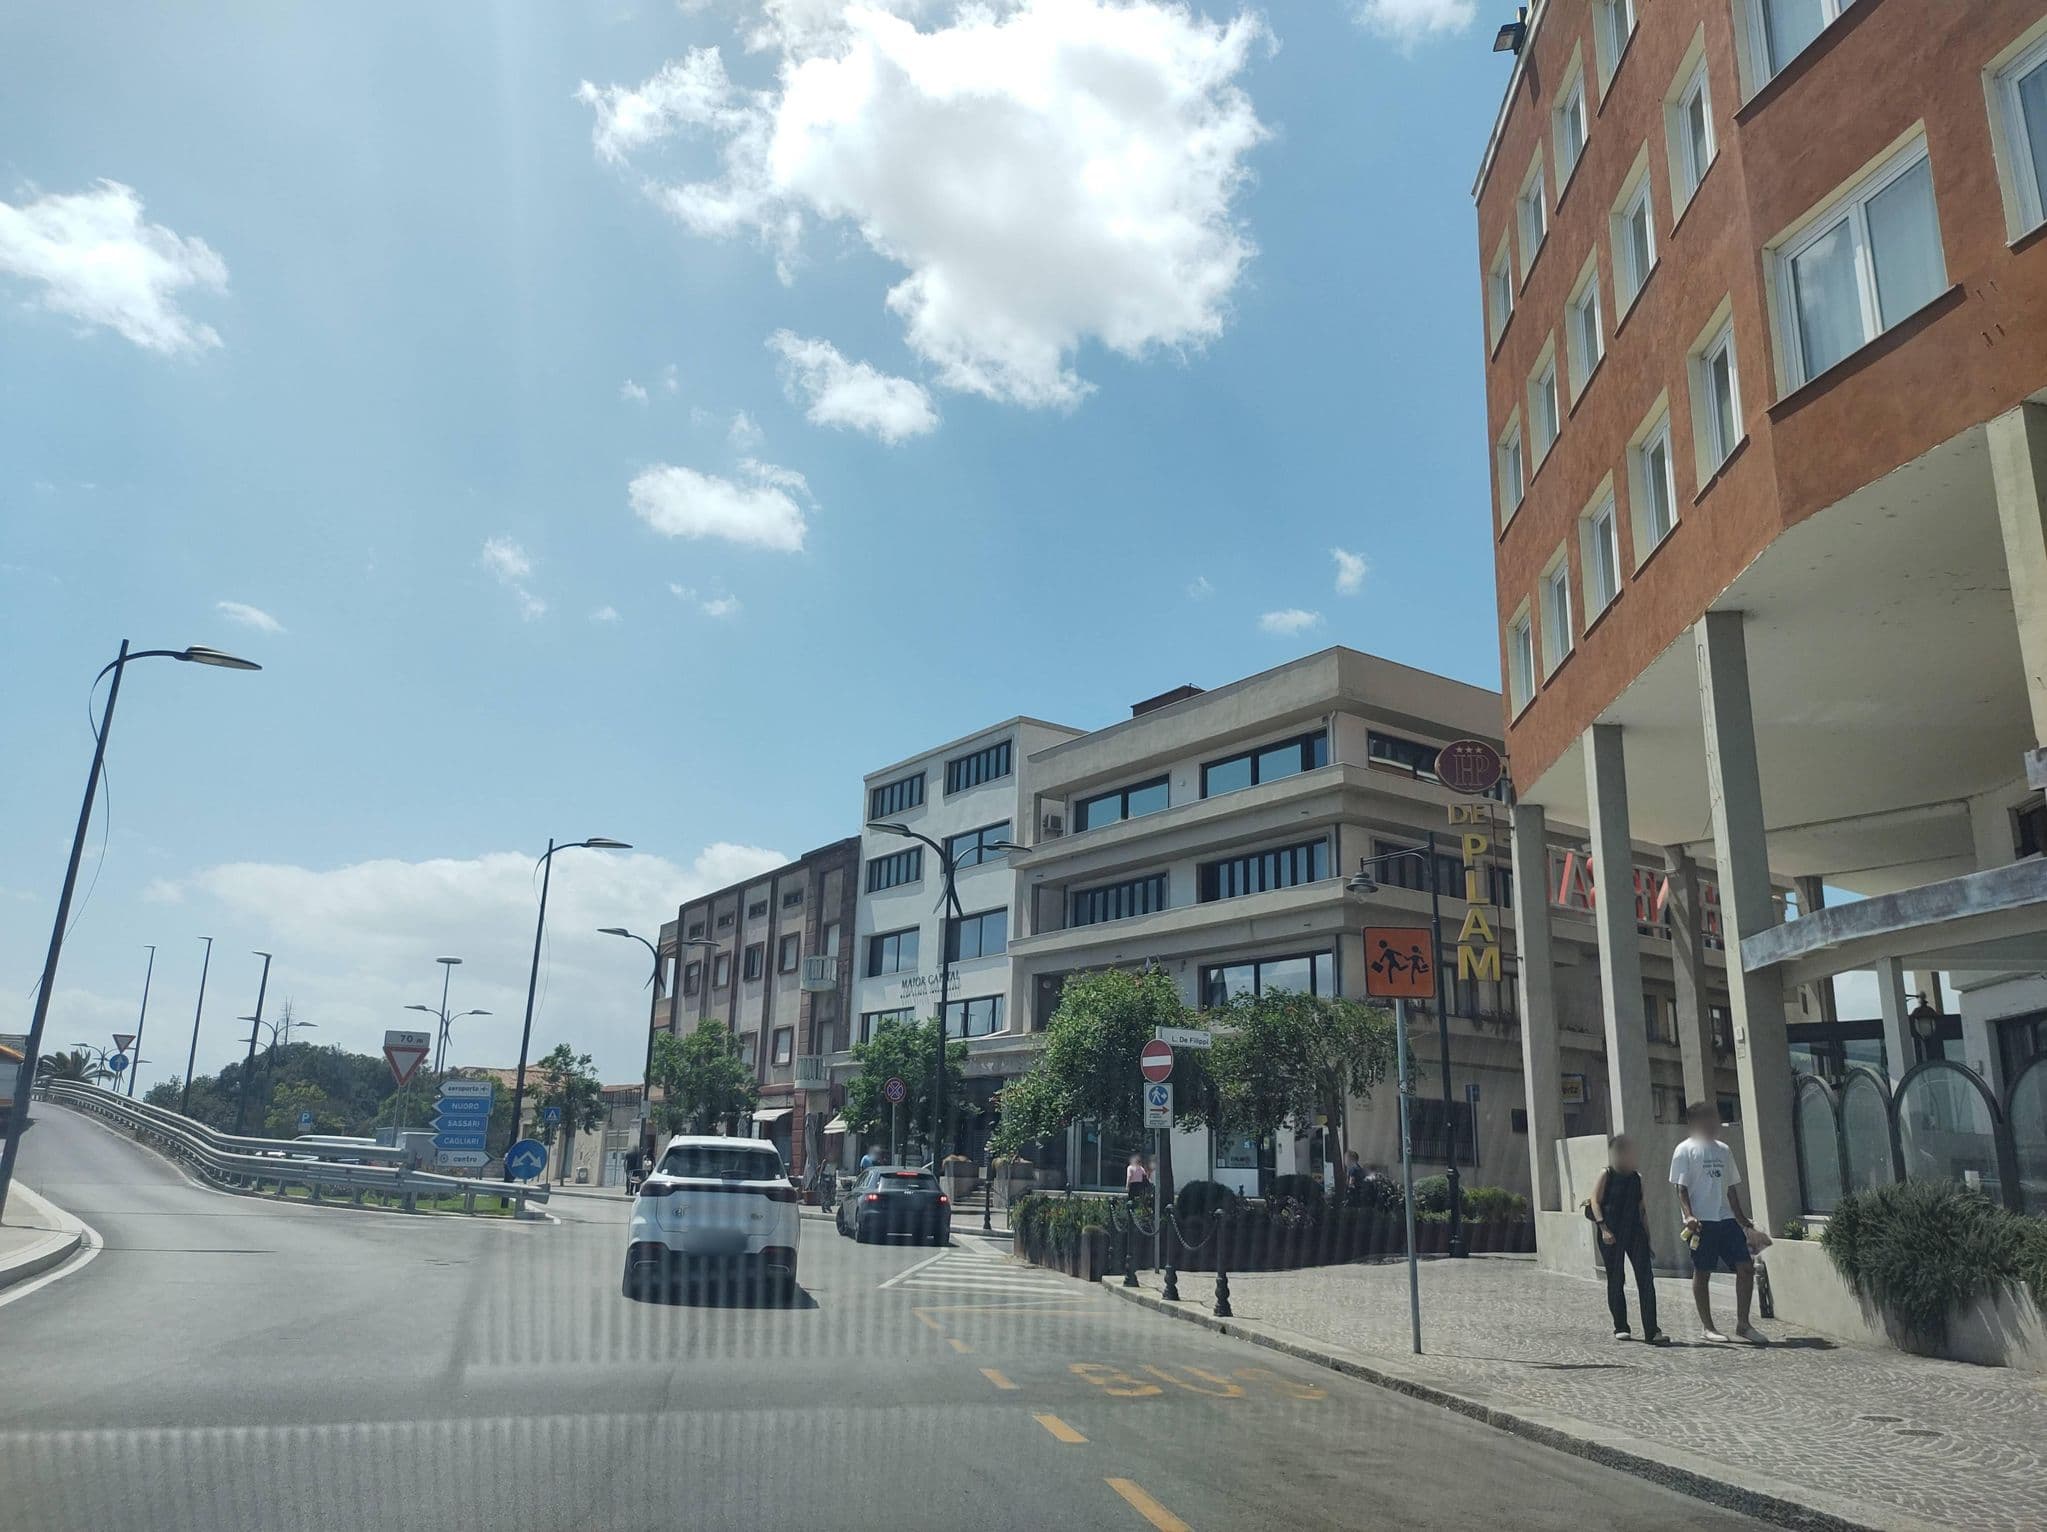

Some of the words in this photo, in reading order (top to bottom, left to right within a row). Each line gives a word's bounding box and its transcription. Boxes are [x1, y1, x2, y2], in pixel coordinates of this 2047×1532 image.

[1448, 803, 1489, 825] DE
[1457, 833, 1500, 982] PLAM
[400, 1034, 413, 1044] 70
[1180, 1036, 1188, 1044] De
[448, 1085, 479, 1093] aeroporto
[302, 1112, 310, 1122] P
[447, 1120, 480, 1128] SASSARI
[453, 1155, 477, 1163] centro
[1068, 1362, 1329, 1399] BUS
